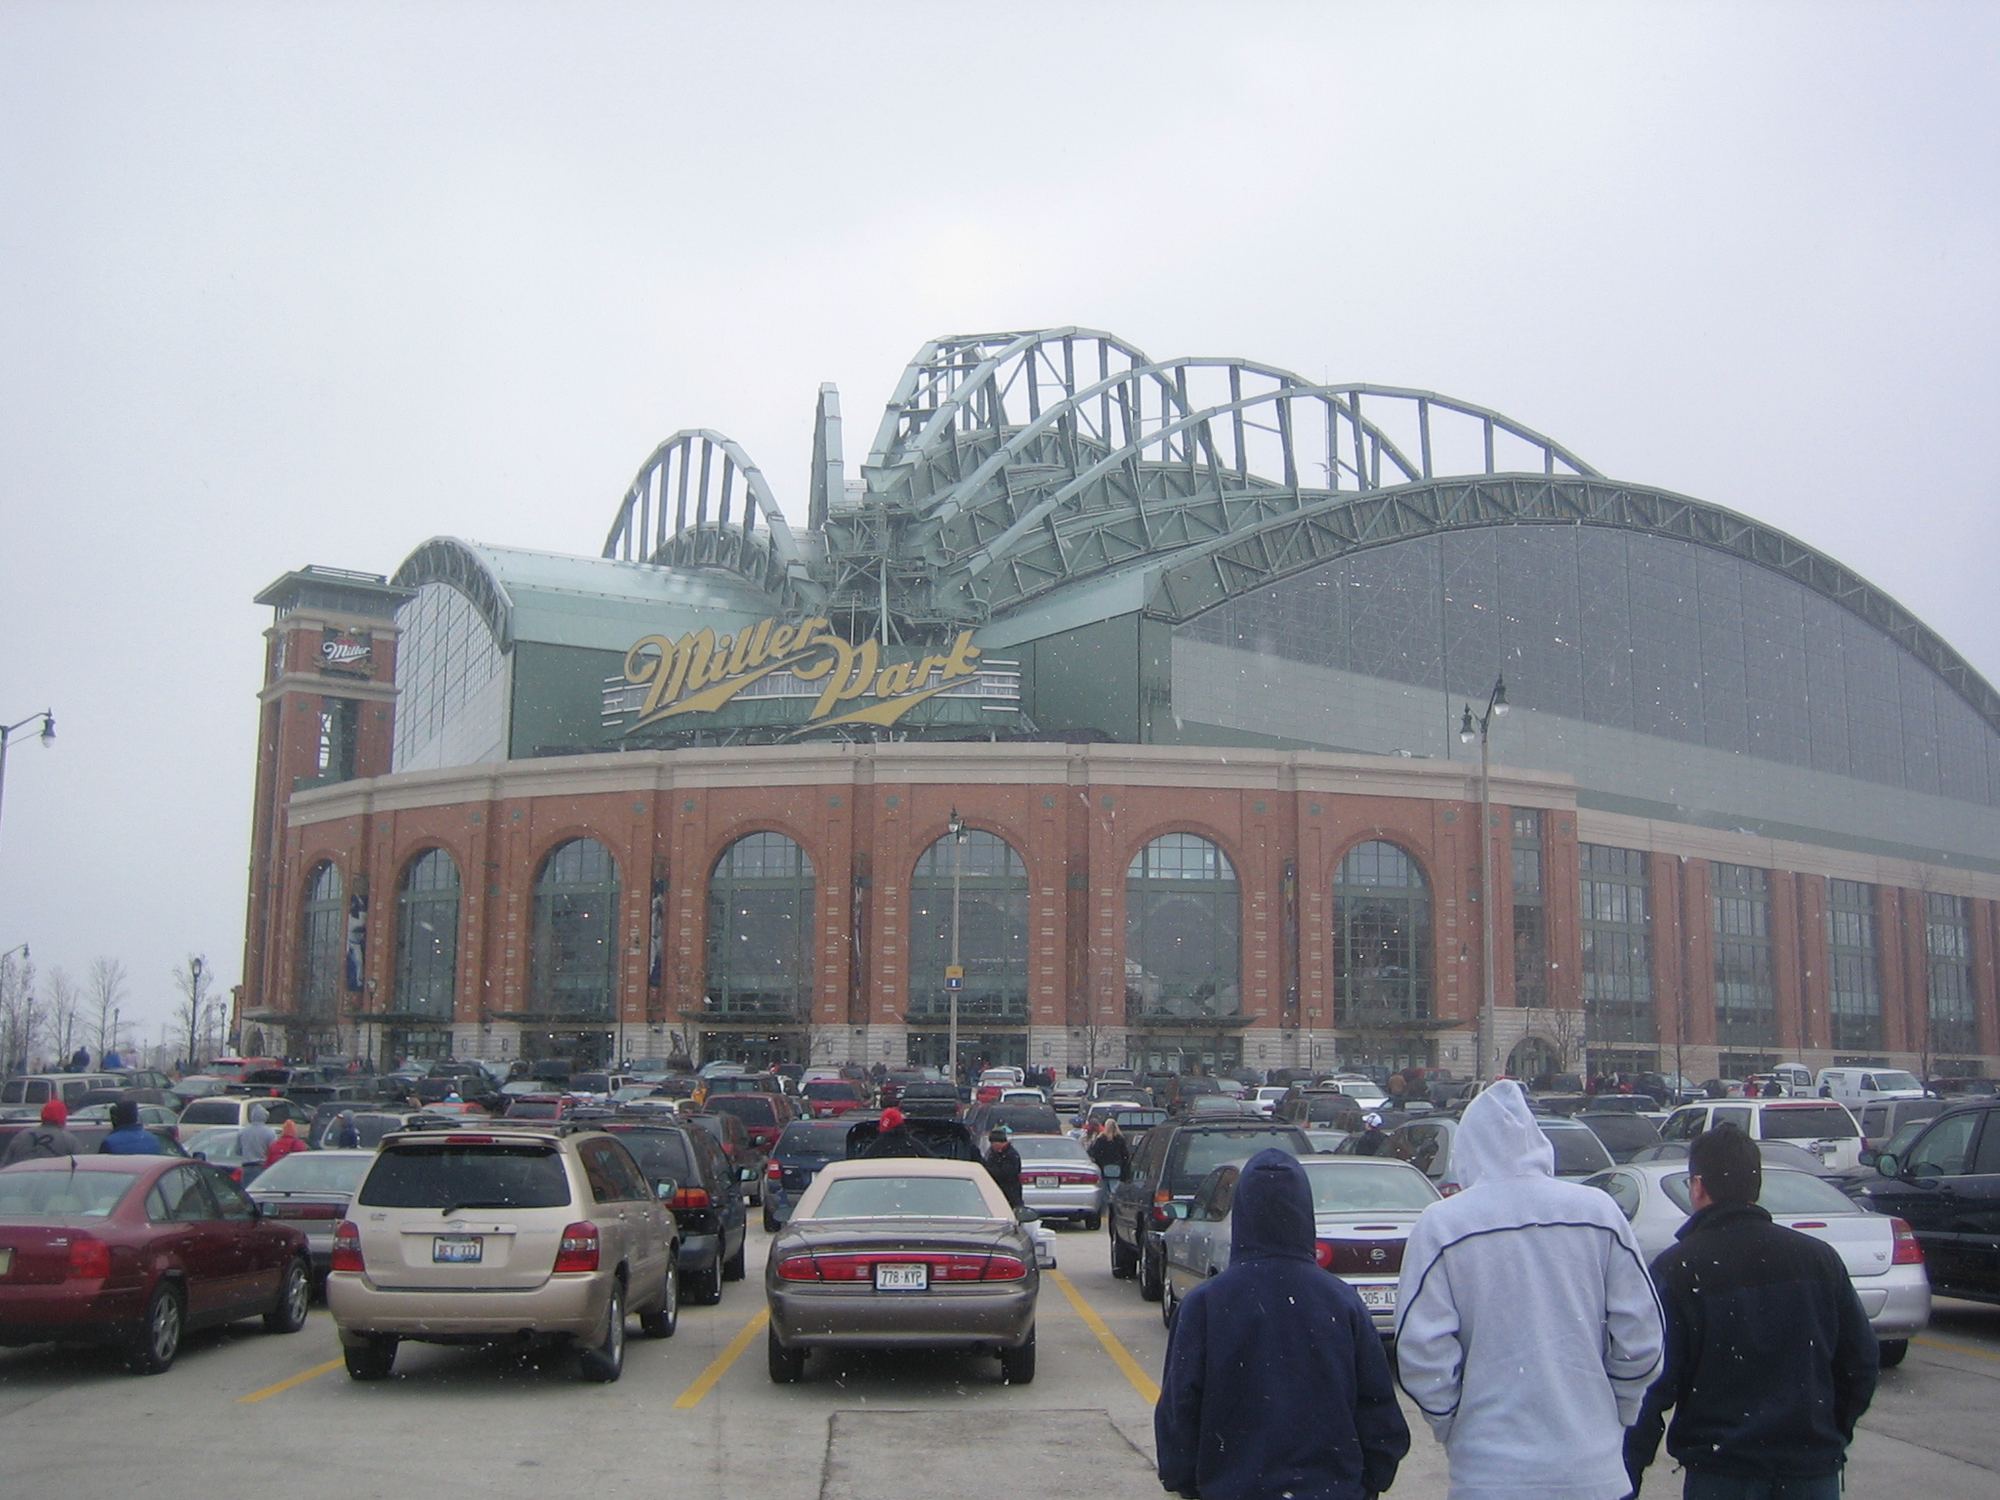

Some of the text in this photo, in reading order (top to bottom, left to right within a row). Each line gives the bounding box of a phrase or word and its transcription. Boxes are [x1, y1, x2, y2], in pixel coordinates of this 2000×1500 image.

[322, 641, 371, 660] Miller
[624, 616, 982, 721] Miller Park
[881, 1270, 922, 1284] 778-KYP
